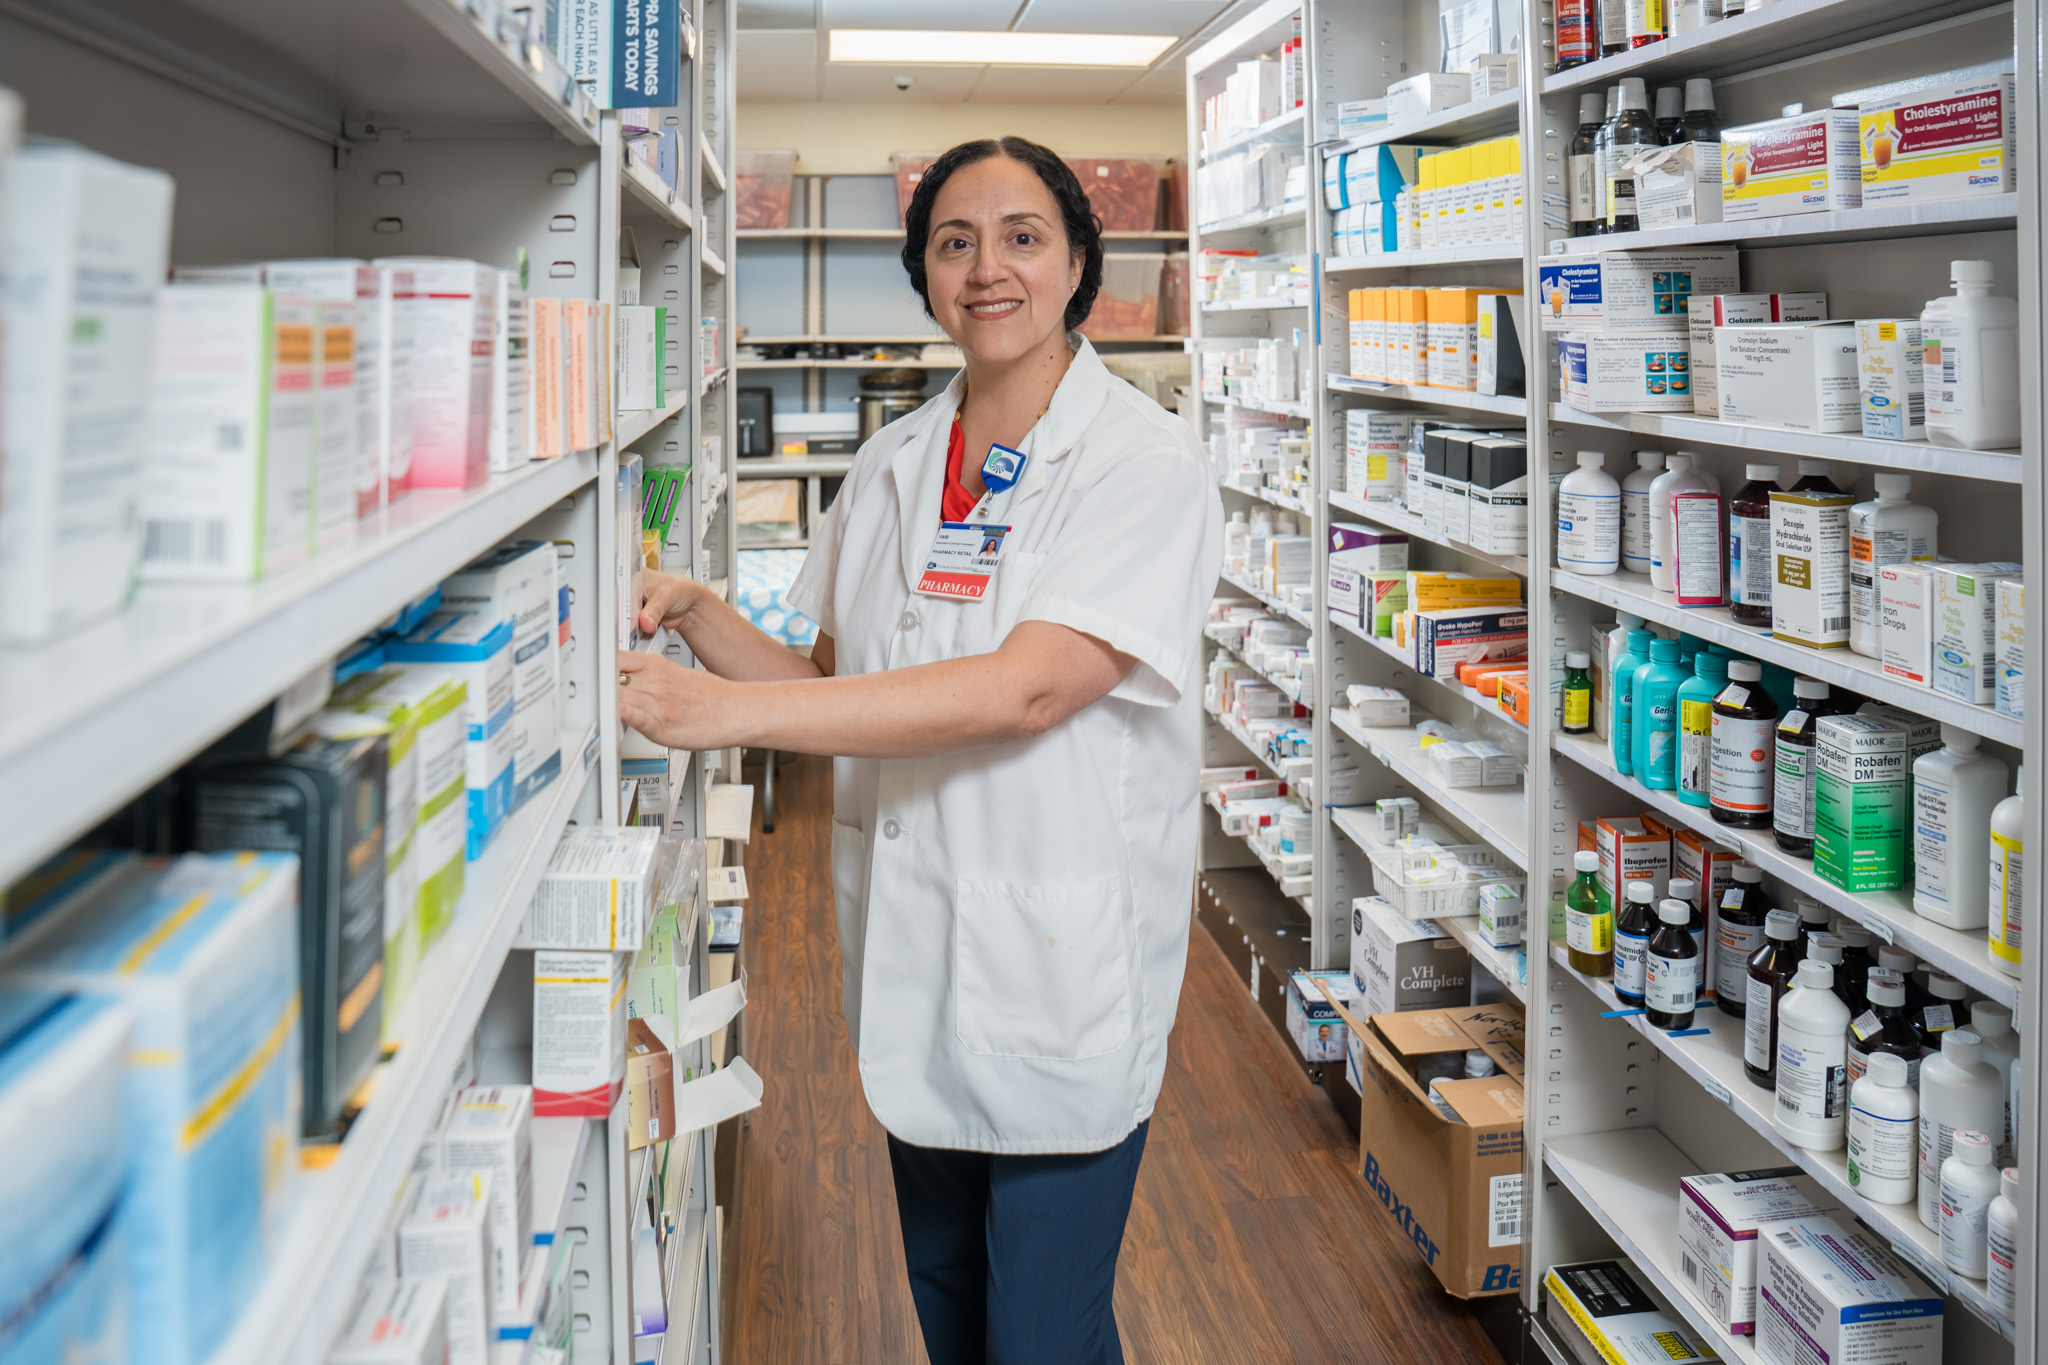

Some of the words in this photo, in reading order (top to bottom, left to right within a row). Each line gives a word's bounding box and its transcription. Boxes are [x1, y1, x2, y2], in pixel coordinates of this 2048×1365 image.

[589, 18, 598, 57] LITTLE
[574, 41, 583, 78] INHAL
[588, 59, 598, 74] AS
[625, 38, 638, 91] TODAY
[645, 29, 658, 96] SAVINGS
[1903, 95, 1997, 121] Cholestyramine
[1926, 120, 1958, 132] Suspension
[1974, 111, 1997, 123] Light
[1757, 127, 1823, 148] Cholestyramine
[1968, 176, 1998, 185] ASCEND
[1879, 366, 1894, 375] Drops
[1783, 519, 1804, 529] Doxepin
[1776, 529, 1812, 543] Hydrochloride
[1786, 542, 1802, 551] Solution
[1852, 544, 1869, 553] Sulfate
[919, 580, 985, 596] PHARMACY
[1883, 605, 1897, 617] Iron
[1883, 617, 1906, 630] Drops
[1946, 623, 1962, 637] Drops
[1654, 706, 1676, 715] Geri-L
[1818, 725, 1837, 739] MAJOR
[1912, 727, 1932, 736] MAJOR
[1855, 738, 1885, 747] MAJOR
[1817, 743, 1847, 765] Robafen
[1816, 755, 1828, 770] DM
[1855, 757, 1901, 768] Robafen
[1854, 770, 1874, 780] DM
[1918, 800, 1946, 815] Hydrochloride
[1926, 810, 1938, 820] Syrup
[1678, 856, 1701, 876] Ibuprofen
[1369, 943, 1378, 960] VH
[1364, 950, 1389, 984] Complete
[1411, 966, 1434, 979] VH
[1401, 974, 1464, 992] Complete
[1363, 1150, 1440, 1267] Baxter
[1686, 1207, 1701, 1226] BOWEL
[1702, 1224, 1715, 1242] PREP
[1696, 1210, 1714, 1232] SUPREP
[1767, 1252, 1782, 1272] Sodium
[1800, 1288, 1824, 1315] Potassium
[1548, 1278, 1560, 1292] Heparin
[1567, 1299, 1577, 1311] Flush
[1576, 1310, 1590, 1331] Solution,
[1795, 1292, 1821, 1324] Magnesium
[1788, 1295, 1797, 1311] Oral
[1799, 1311, 1817, 1331] Solution
[1656, 1335, 1677, 1357] REFLUX
